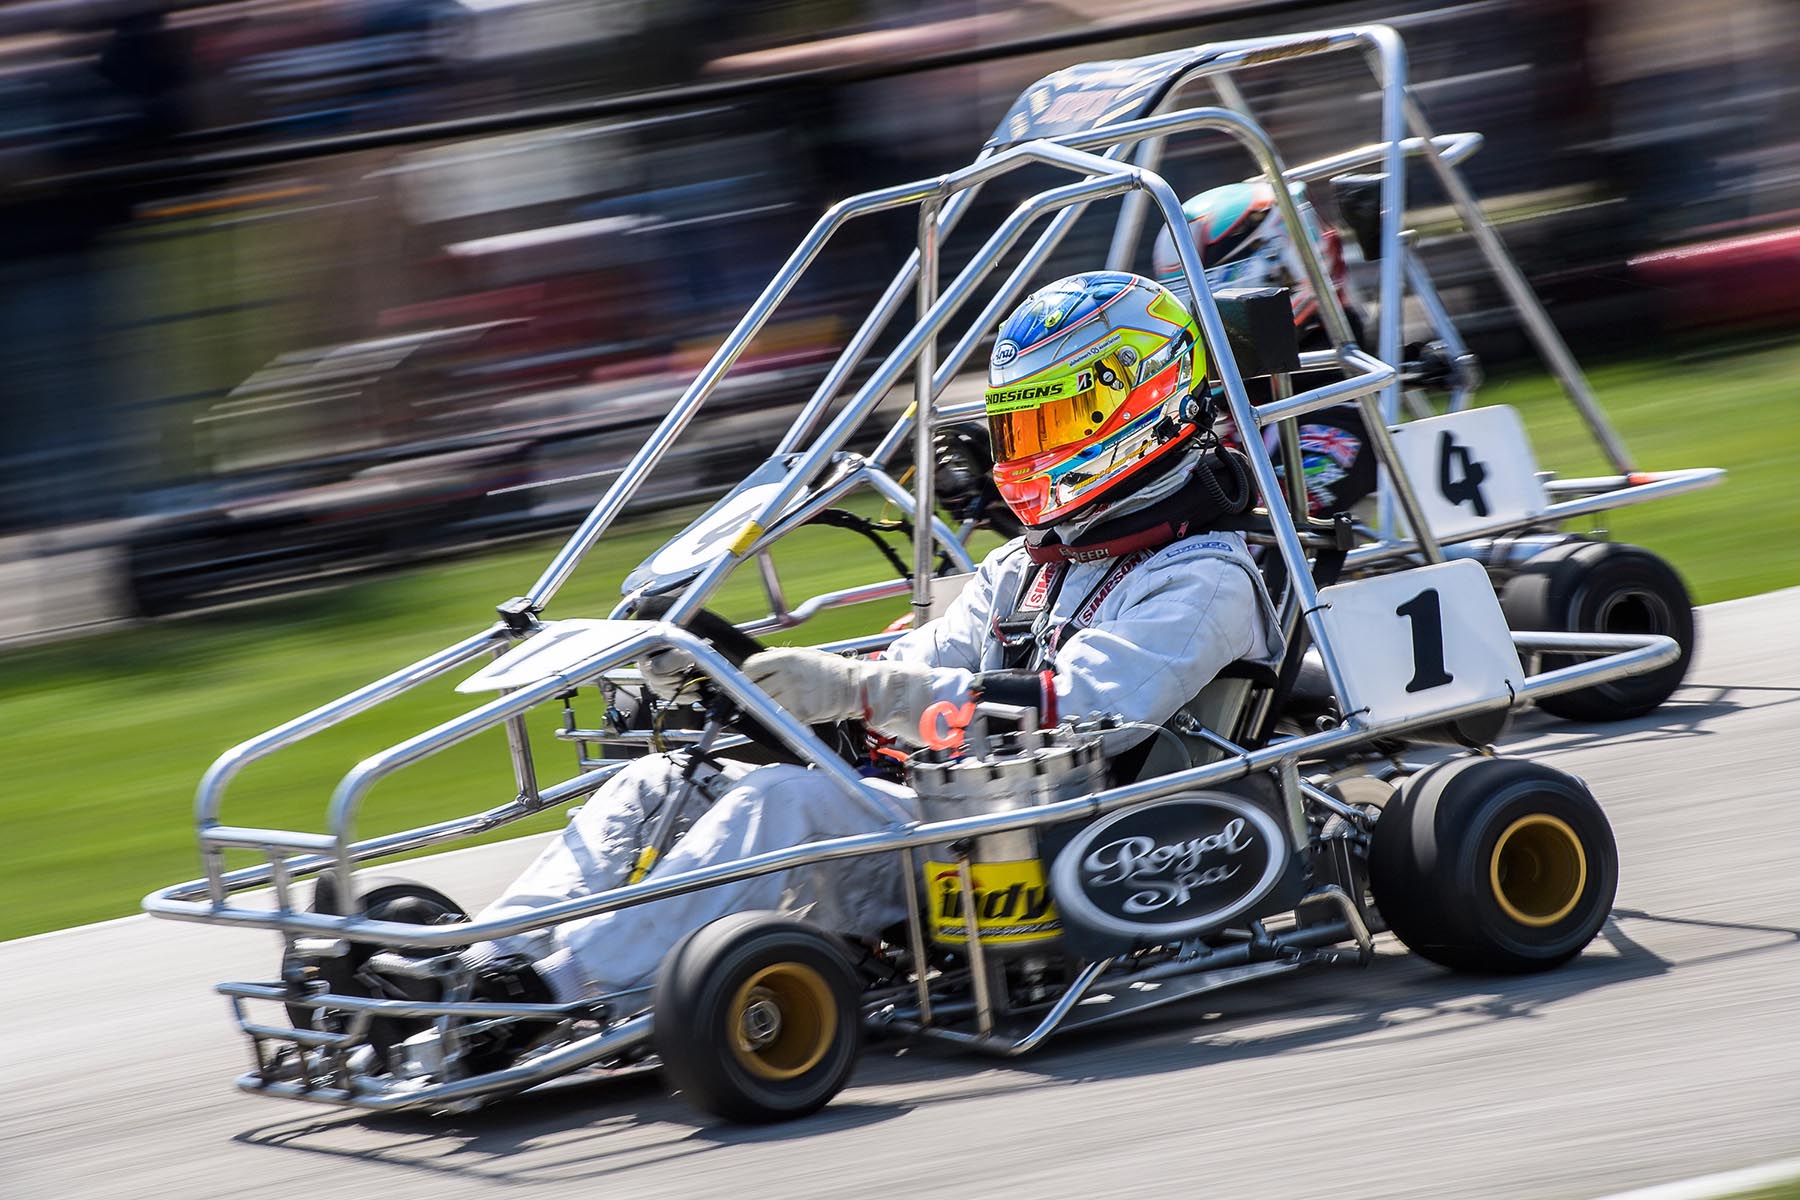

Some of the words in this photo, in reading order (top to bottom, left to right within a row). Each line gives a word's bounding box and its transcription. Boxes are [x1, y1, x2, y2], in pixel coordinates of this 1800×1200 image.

[1438, 430, 1488, 516] 4
[1083, 555, 1143, 622] SIMPSON
[1396, 588, 1454, 692] 1
[1083, 817, 1254, 887] Royal
[1121, 863, 1242, 914] Spa
